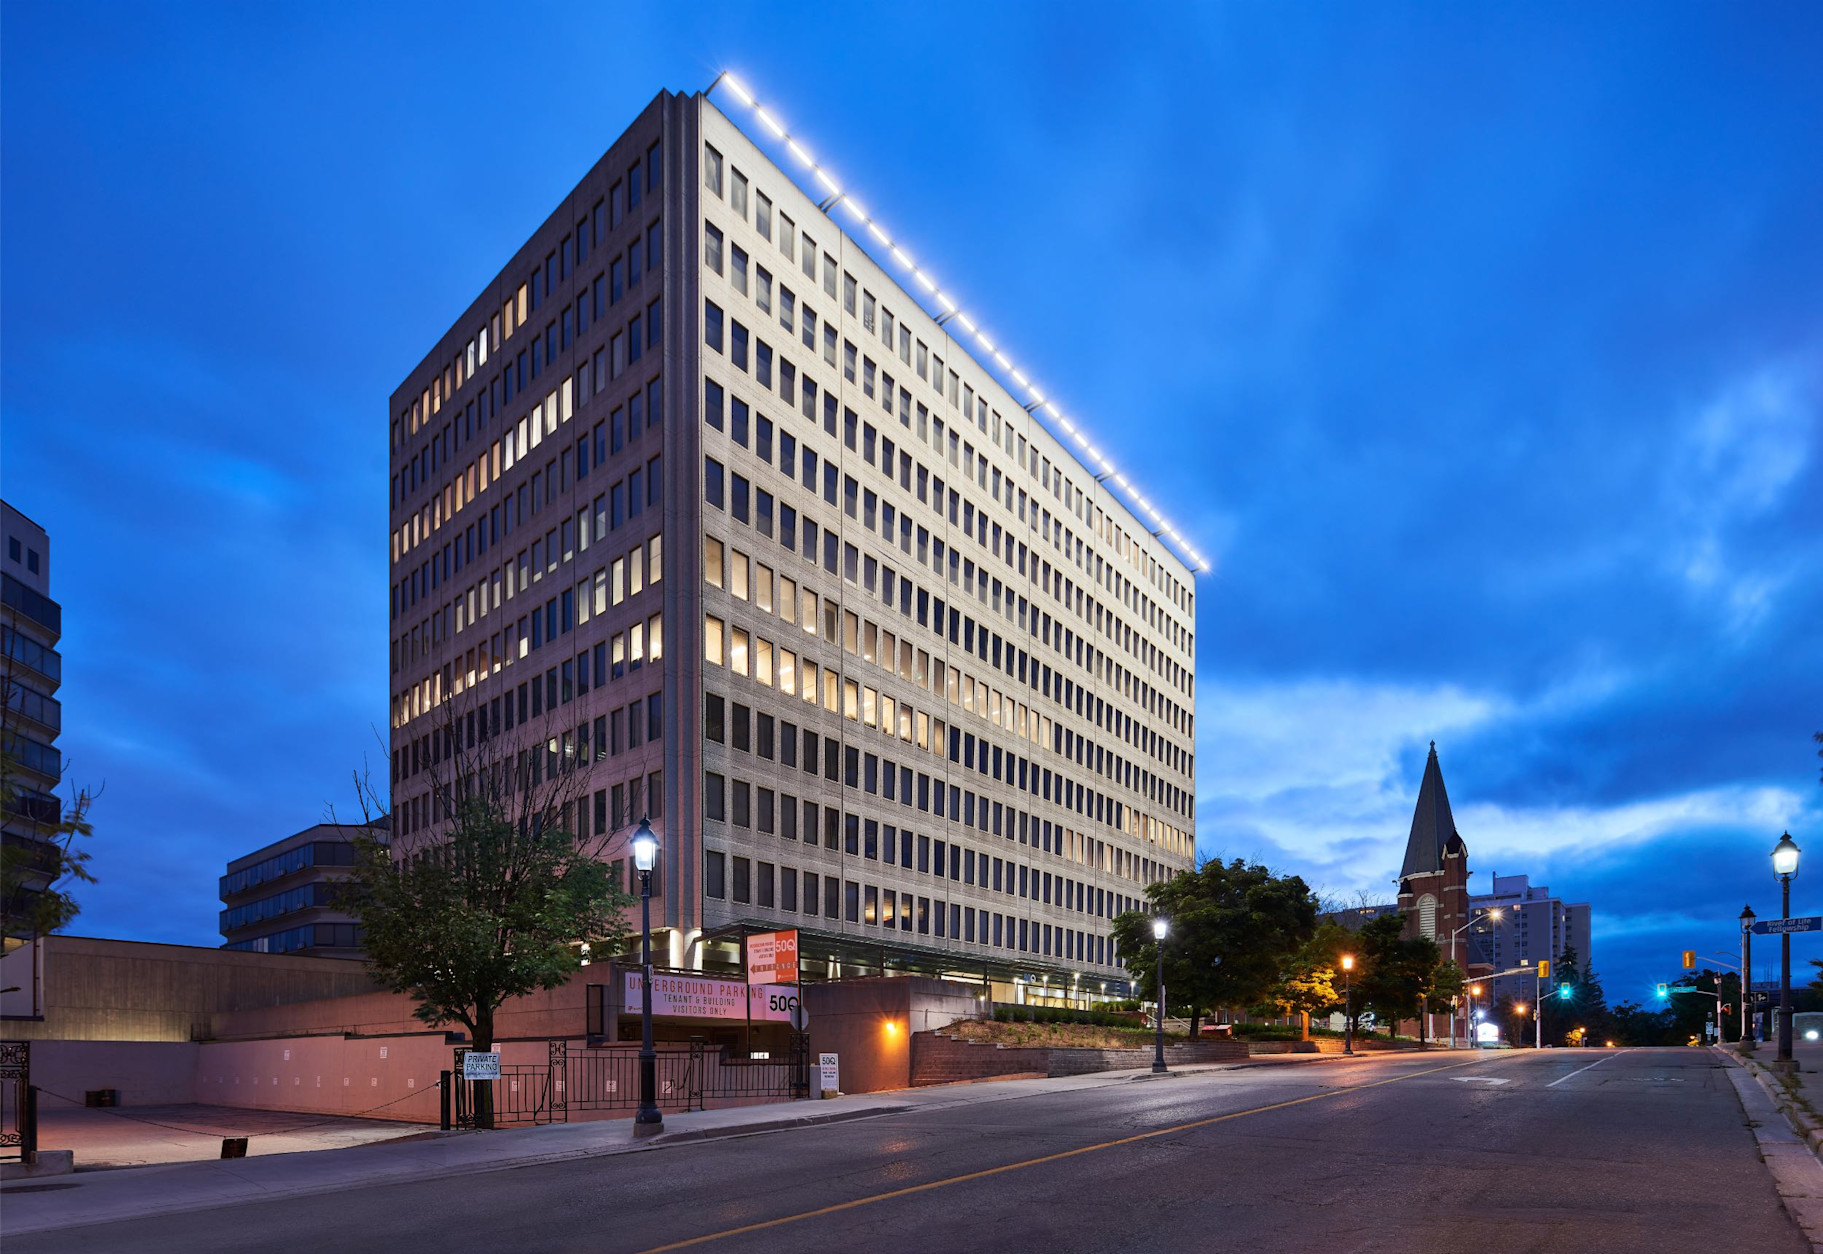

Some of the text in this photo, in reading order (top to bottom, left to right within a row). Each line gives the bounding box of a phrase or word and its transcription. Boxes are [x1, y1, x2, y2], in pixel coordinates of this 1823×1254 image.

[1767, 919, 1788, 927] River
[1798, 917, 1811, 925] Life
[1769, 924, 1809, 933] Fellowship
[775, 939, 796, 952] 50Q
[629, 977, 763, 999] UNERGROUND PARKNG
[664, 994, 735, 1006] TENANT & BUILDING
[673, 1005, 727, 1016] VISITORS ONLY
